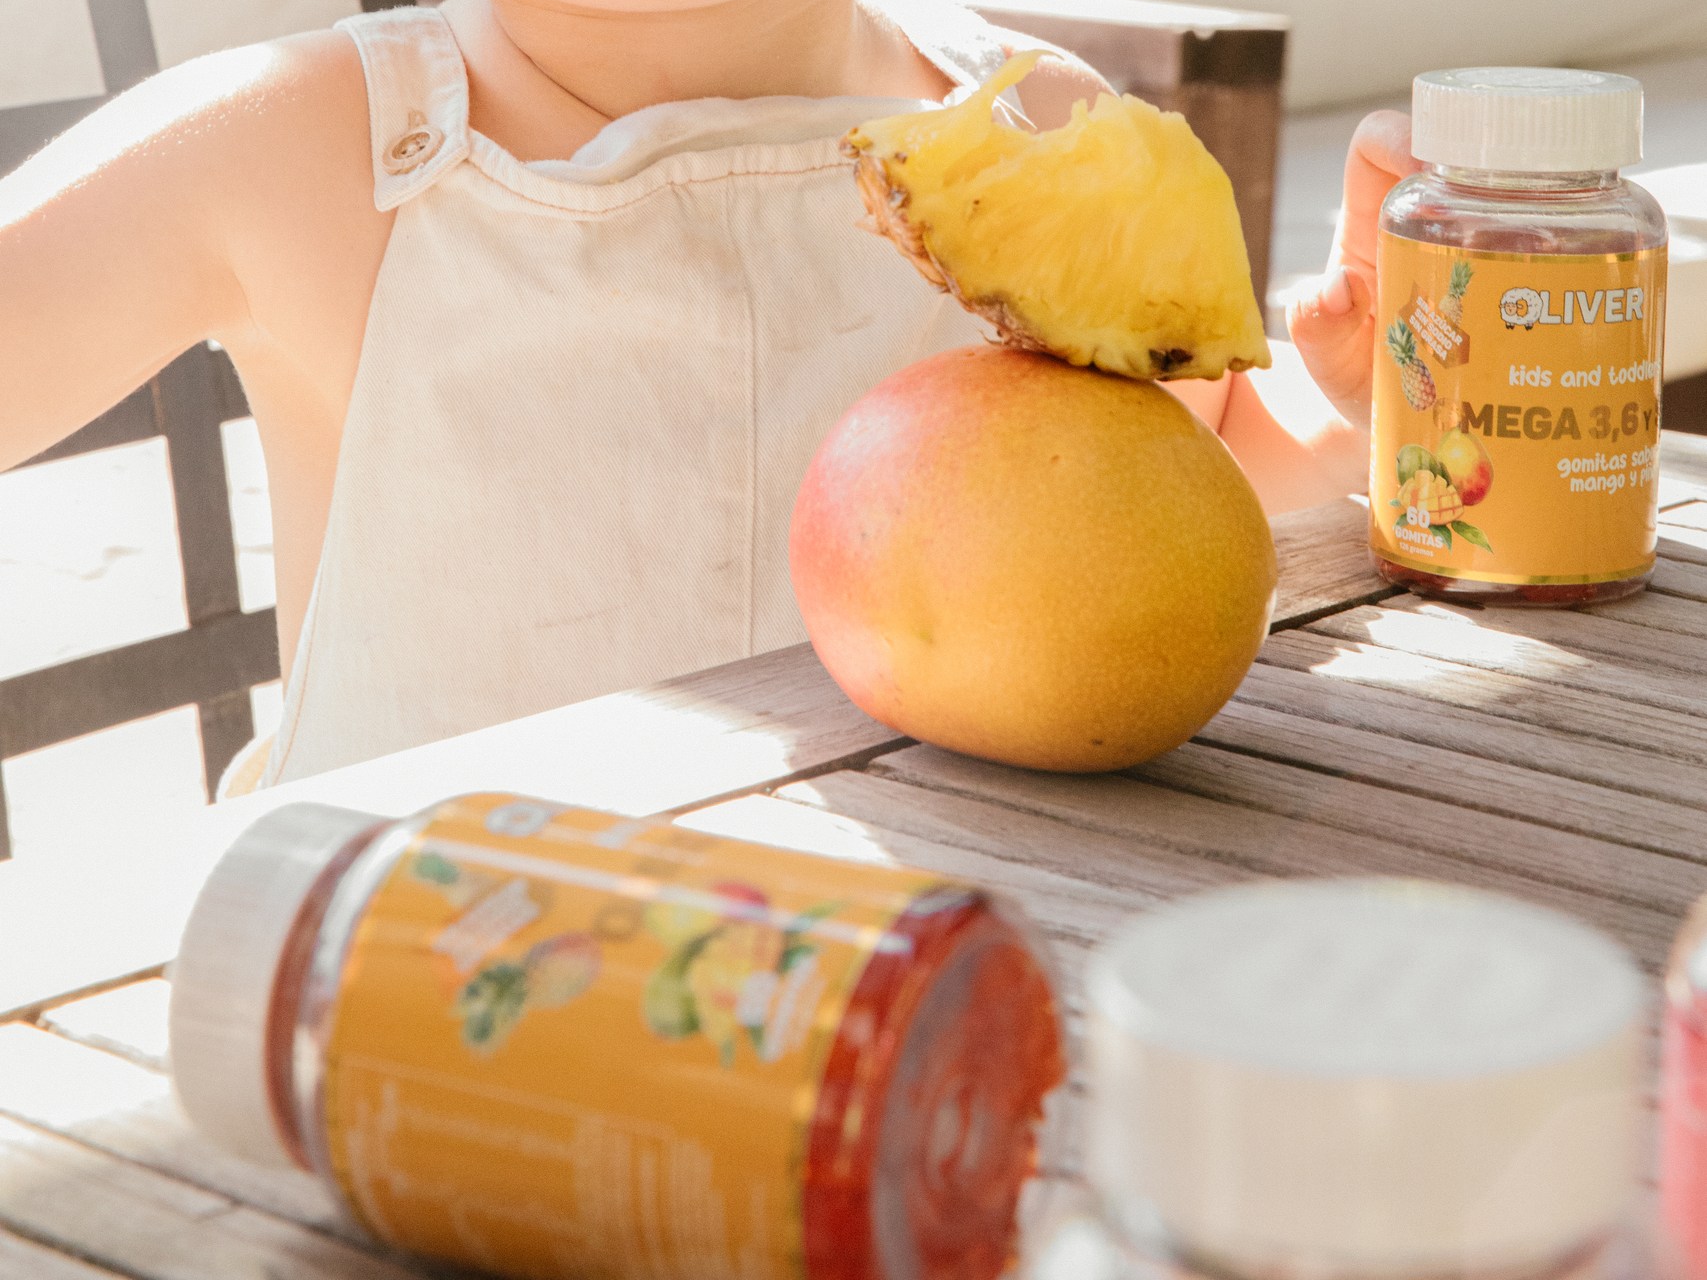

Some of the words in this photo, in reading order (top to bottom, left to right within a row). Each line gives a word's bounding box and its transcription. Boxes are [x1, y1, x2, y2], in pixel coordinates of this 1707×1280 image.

[1499, 286, 1645, 325] OLIVER
[1508, 364, 1553, 388] kids
[1560, 364, 1601, 388] and
[1556, 452, 1627, 479] gomitas
[1569, 473, 1625, 495] mango
[1406, 505, 1431, 529] 60
